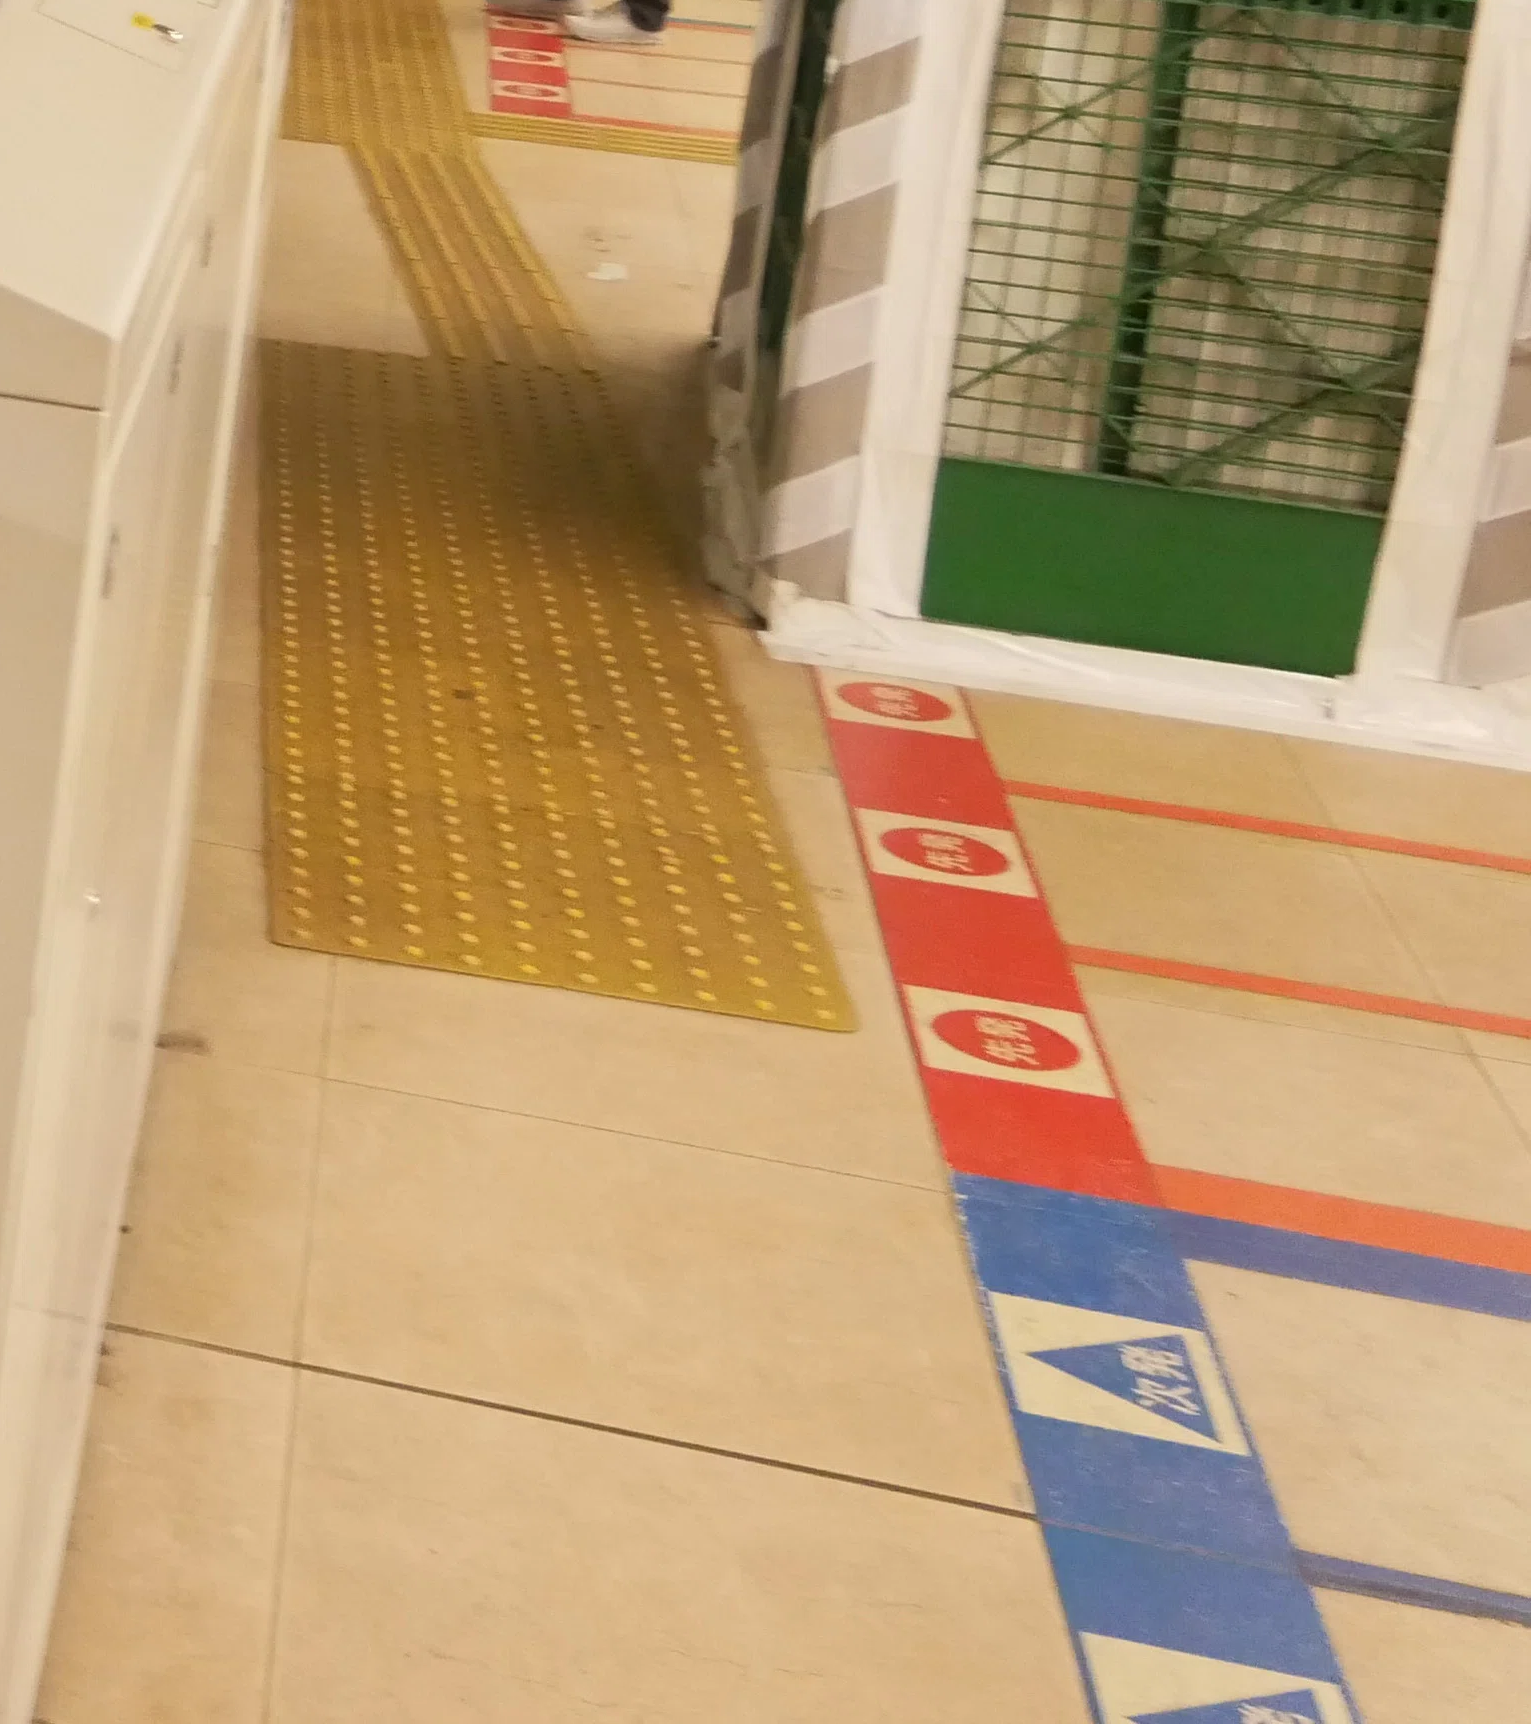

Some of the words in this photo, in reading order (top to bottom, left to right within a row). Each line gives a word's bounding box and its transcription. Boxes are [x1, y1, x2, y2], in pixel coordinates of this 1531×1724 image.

[918, 833, 974, 872] 先発
[972, 1014, 1040, 1065] 先発
[1117, 1343, 1201, 1416] 次発
